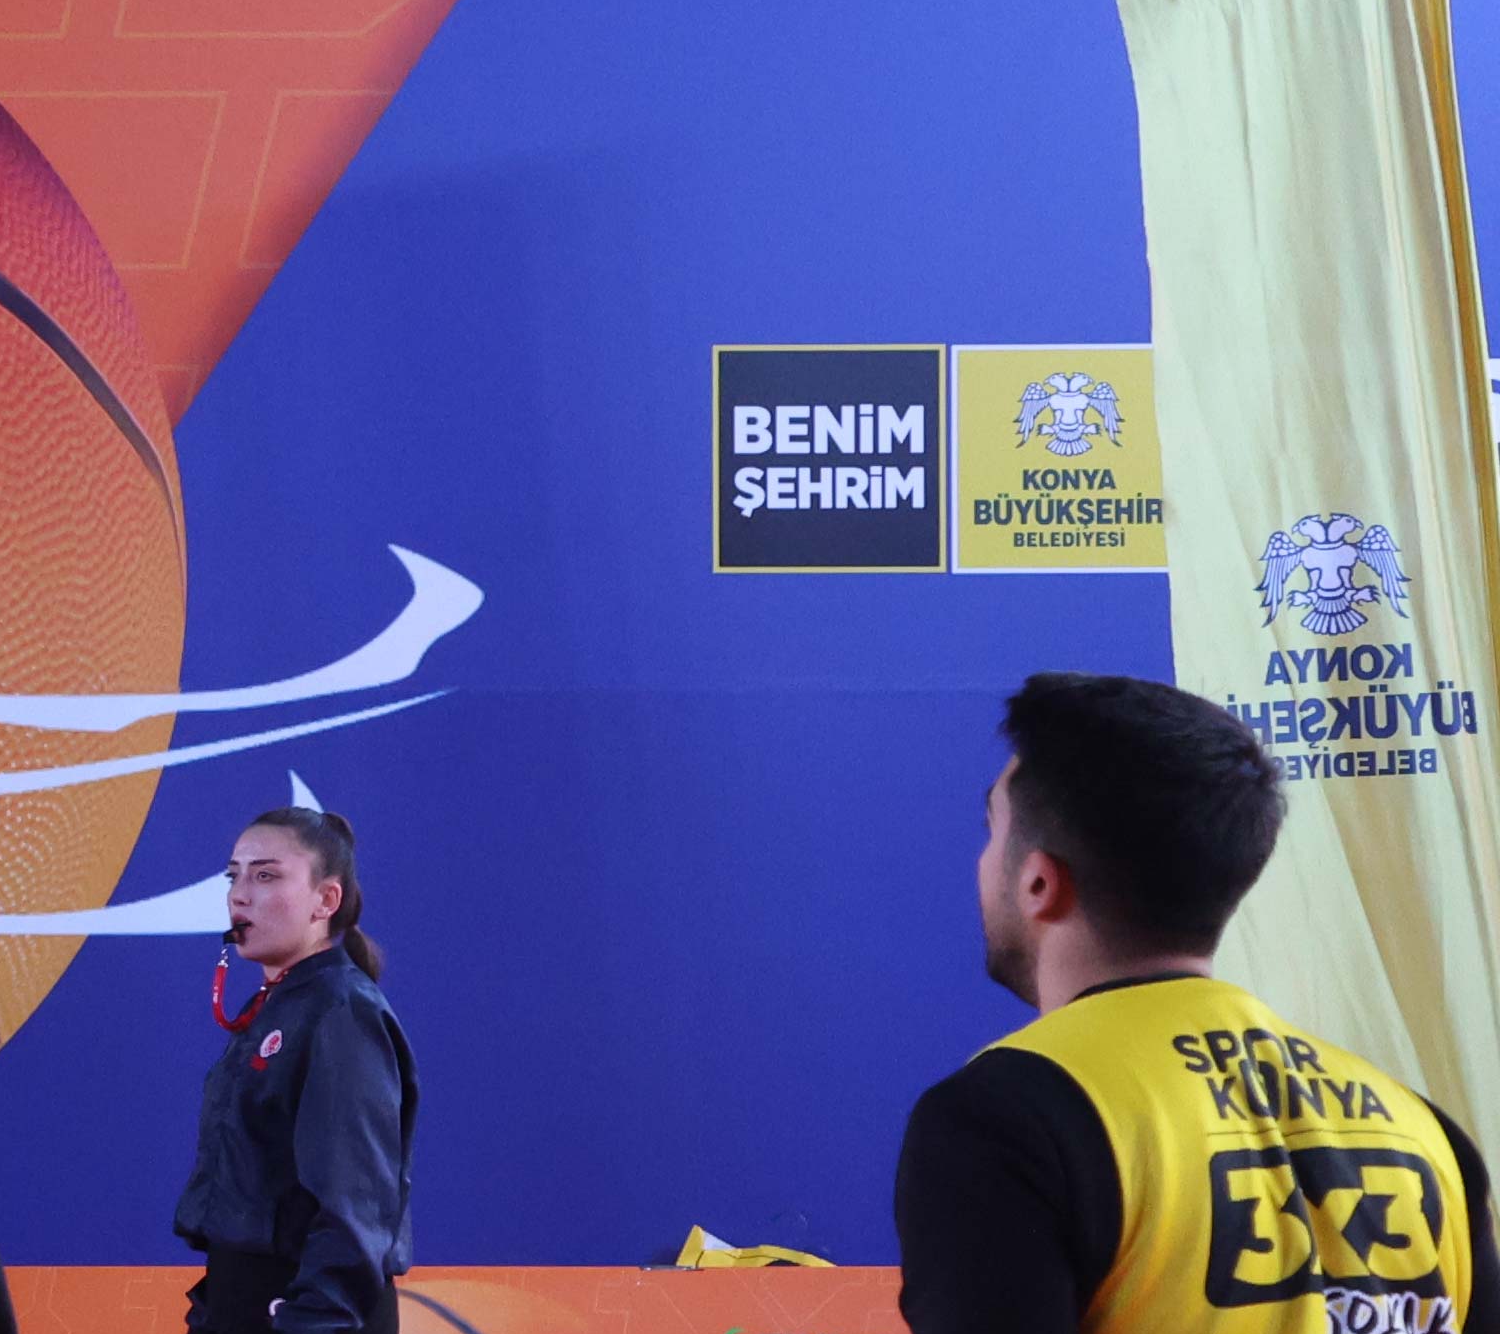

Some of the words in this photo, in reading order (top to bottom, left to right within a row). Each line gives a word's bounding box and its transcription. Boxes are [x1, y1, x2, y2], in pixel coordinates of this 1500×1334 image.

[1022, 469, 1117, 491] KONYA
[973, 492, 1164, 530] BÜYÜKŞEHİR
[1012, 527, 1126, 548] BELEDİYESİ
[1172, 1028, 1327, 1079] SPOR
[1206, 1061, 1394, 1123] KONYA
